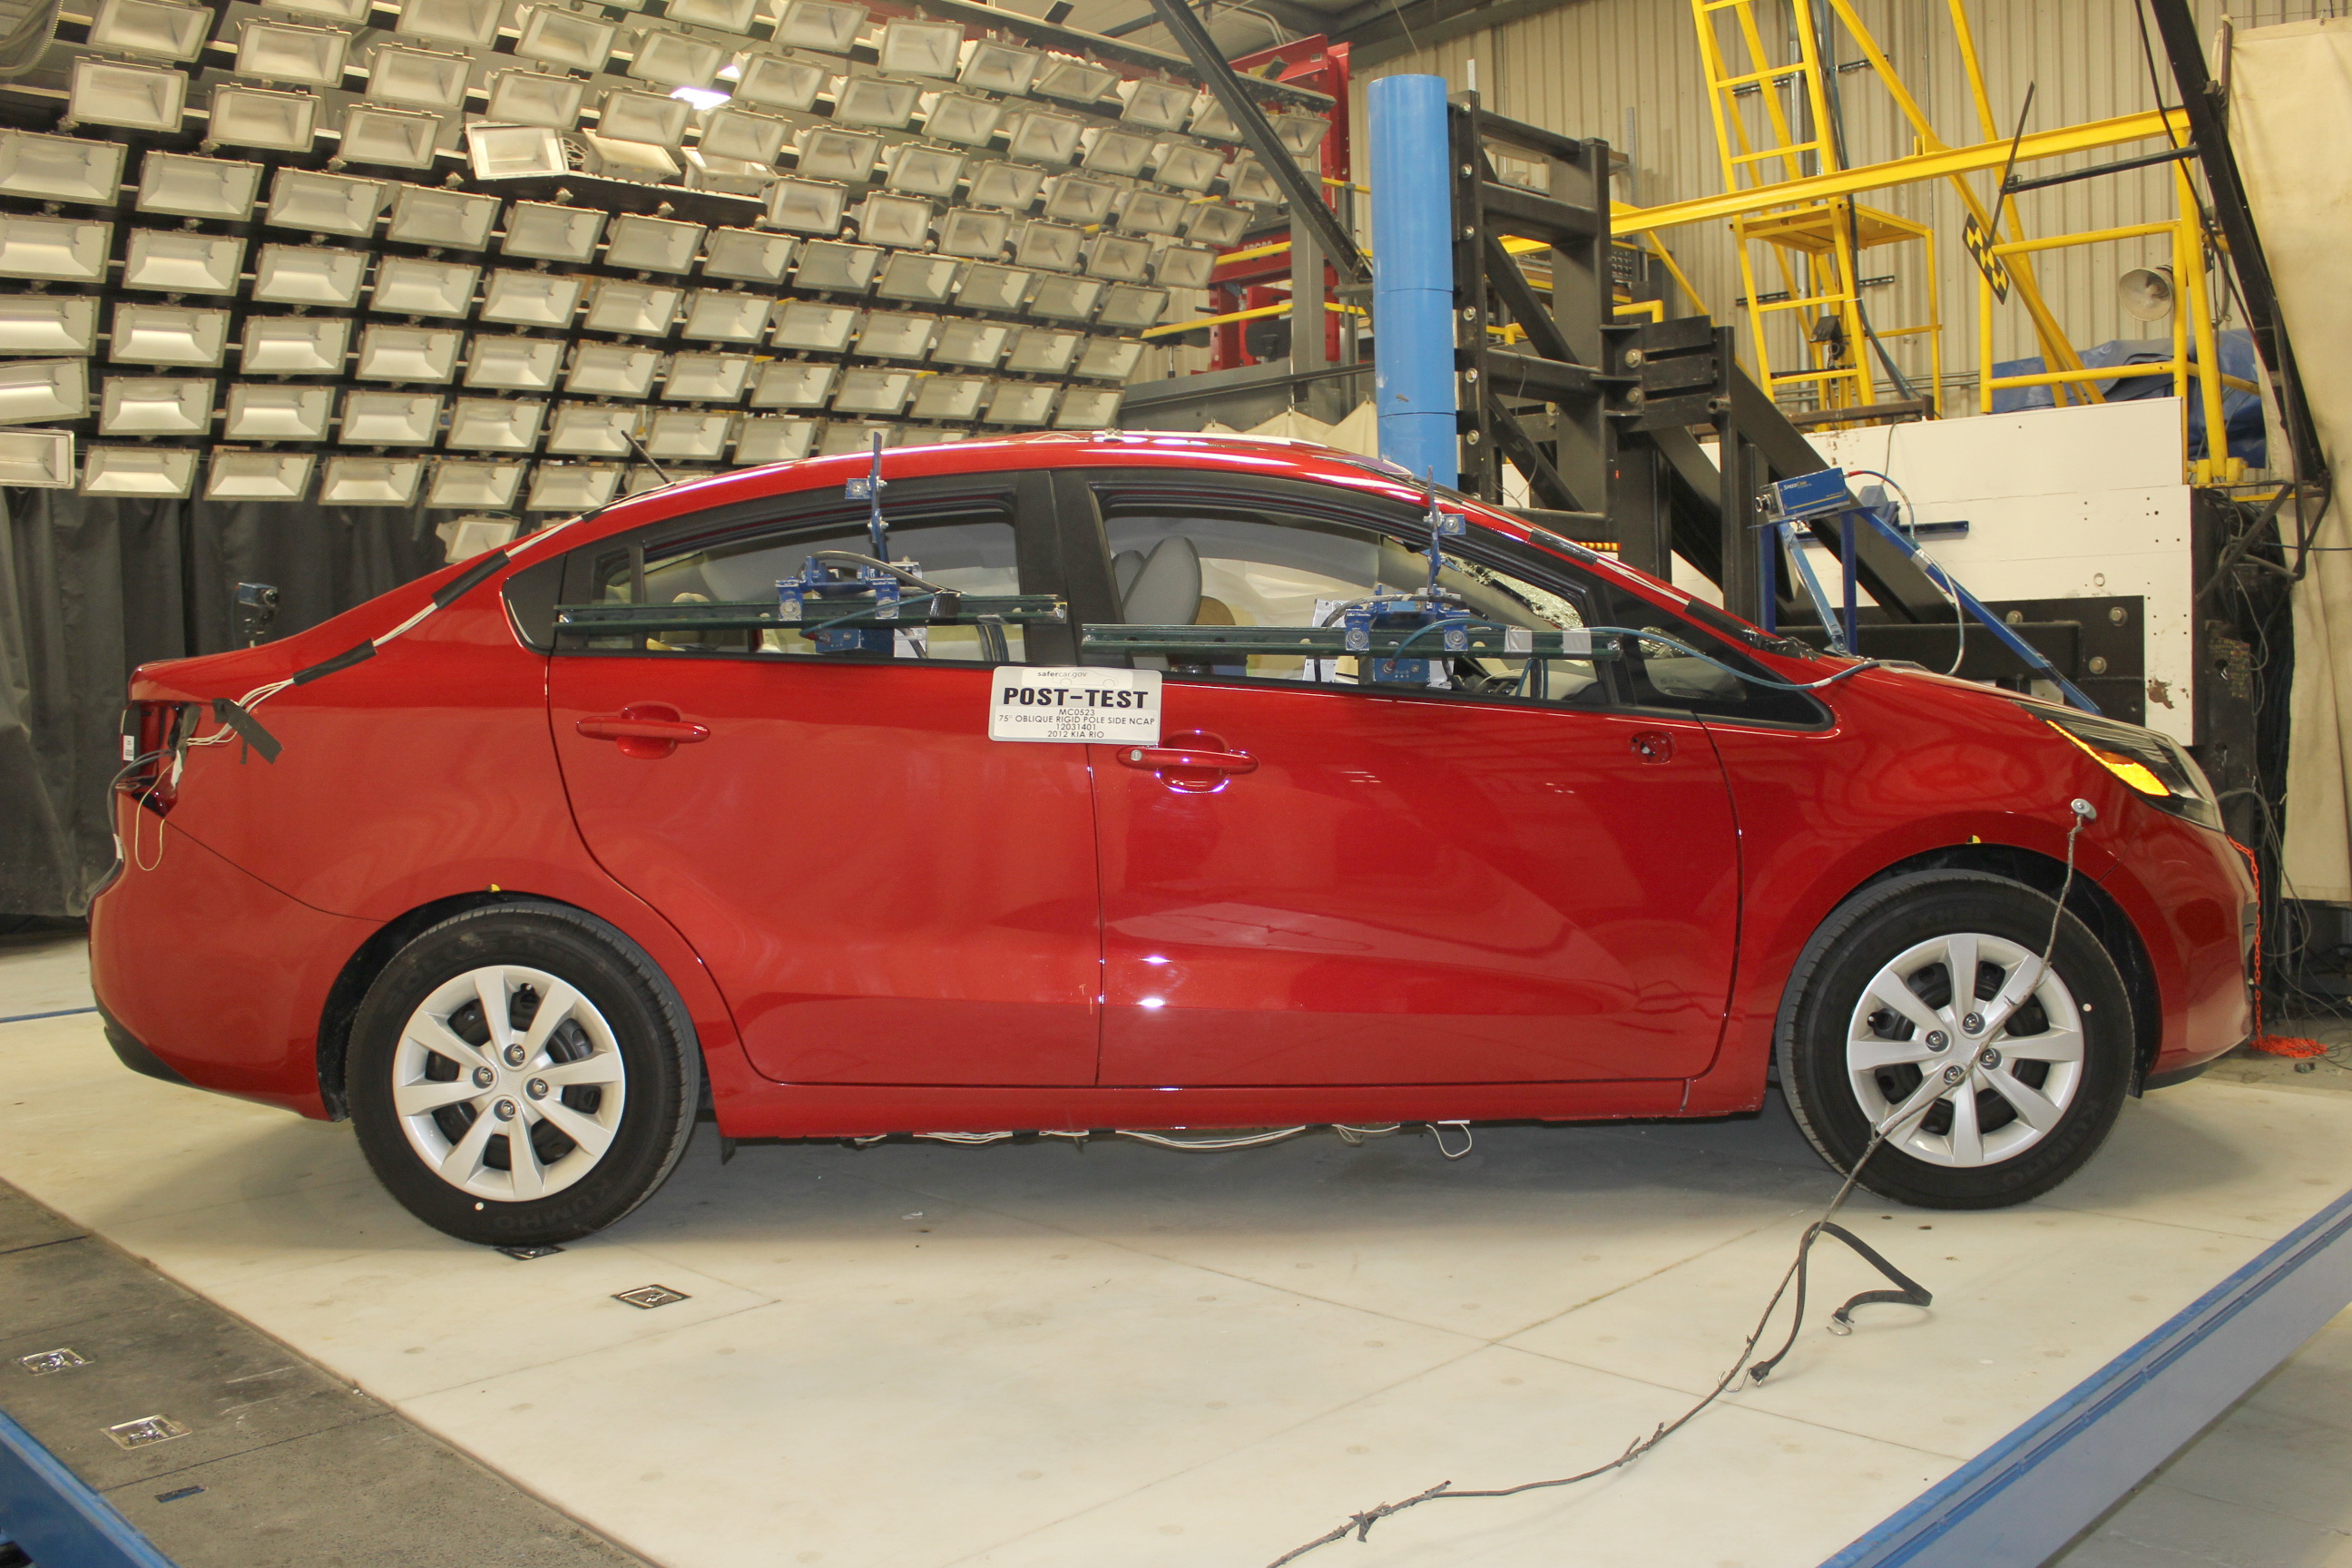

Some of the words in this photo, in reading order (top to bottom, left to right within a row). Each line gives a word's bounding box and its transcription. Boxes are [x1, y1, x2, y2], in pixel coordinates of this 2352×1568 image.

[1037, 670, 1088, 679] safercar.gov
[1003, 687, 1149, 709] POST-TEST
[1058, 708, 1095, 716] MC0523
[998, 714, 1013, 722] 75°
[1014, 715, 1054, 723] OBLIQUE
[1083, 716, 1105, 724] POLE
[1107, 717, 1127, 725] SIDE
[1056, 723, 1096, 731] 12031401
[1047, 730, 1068, 738] 2012
[1089, 730, 1104, 739] RIO
[2001, 1098, 2102, 1189] KUMHO
[493, 1175, 614, 1230] KUMHO
